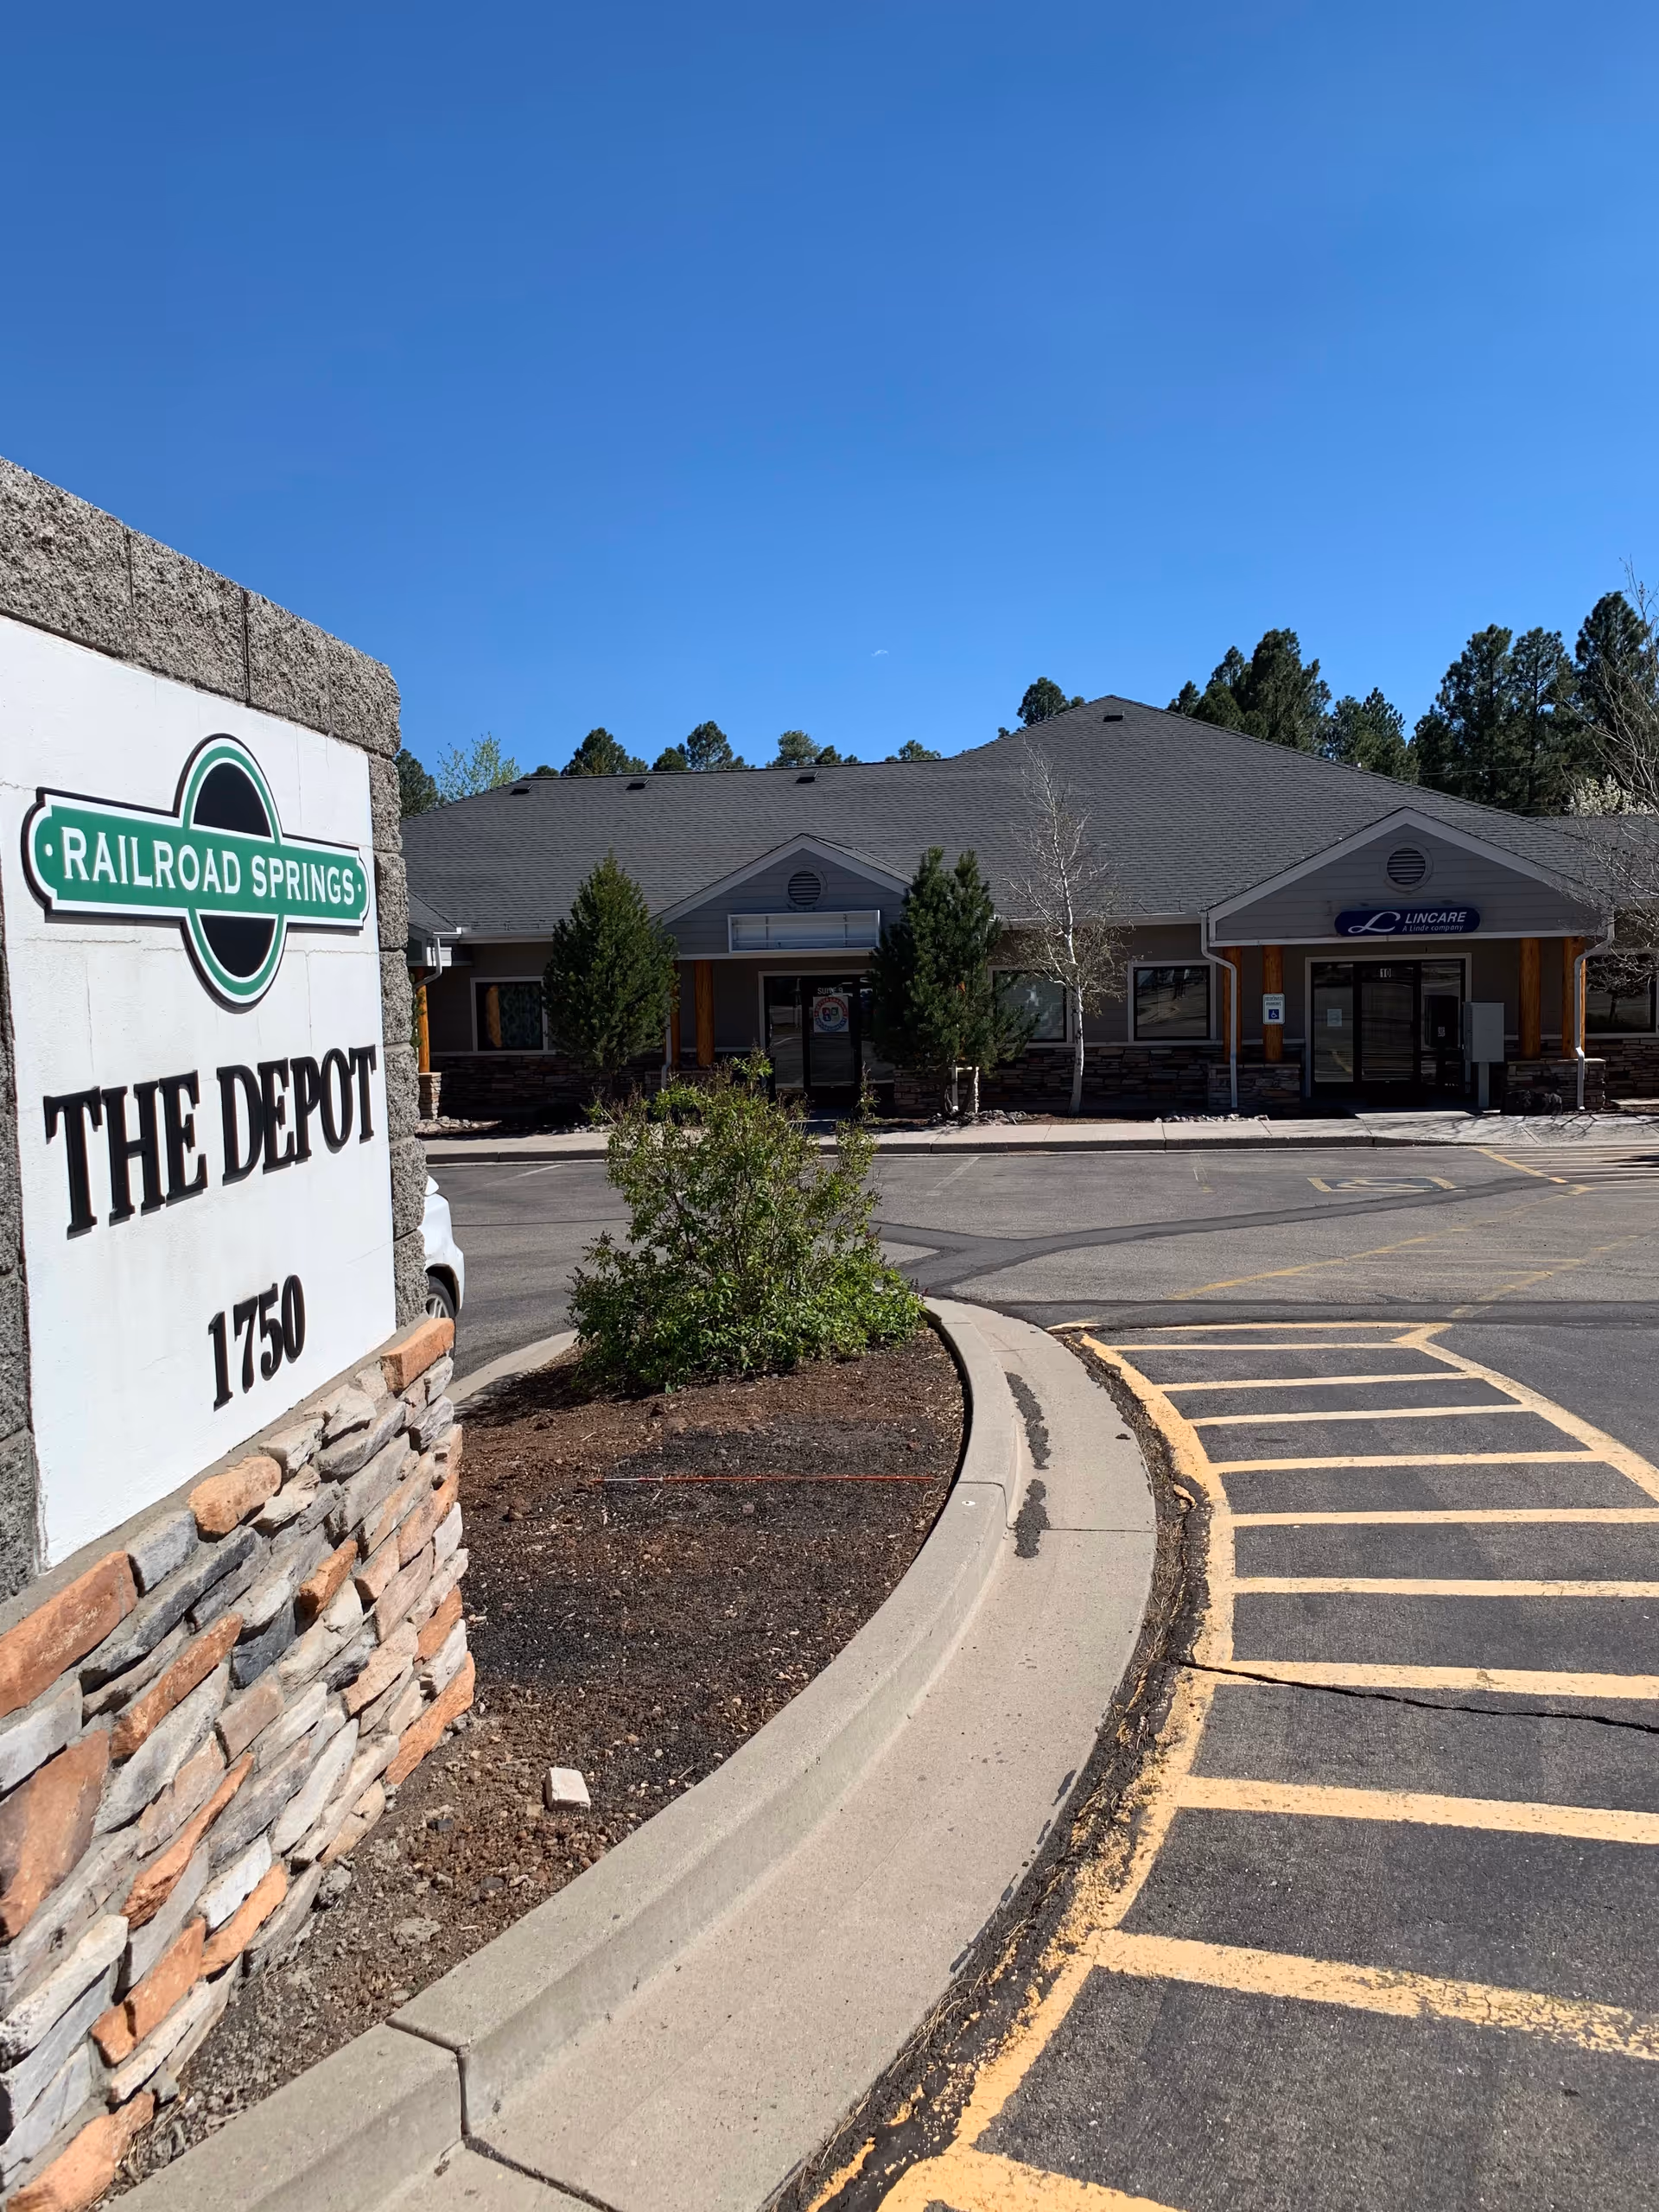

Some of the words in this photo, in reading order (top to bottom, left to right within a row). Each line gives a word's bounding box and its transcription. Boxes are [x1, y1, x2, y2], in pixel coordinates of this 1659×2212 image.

[61, 826, 241, 894] RAILROAD
[251, 857, 355, 905] SPRINGS
[1404, 912, 1467, 924] LINCARE
[1382, 967, 1391, 977] 10
[43, 1070, 207, 1238] THE
[216, 1045, 377, 1185] DEPOT
[208, 1274, 306, 1409] 1750
